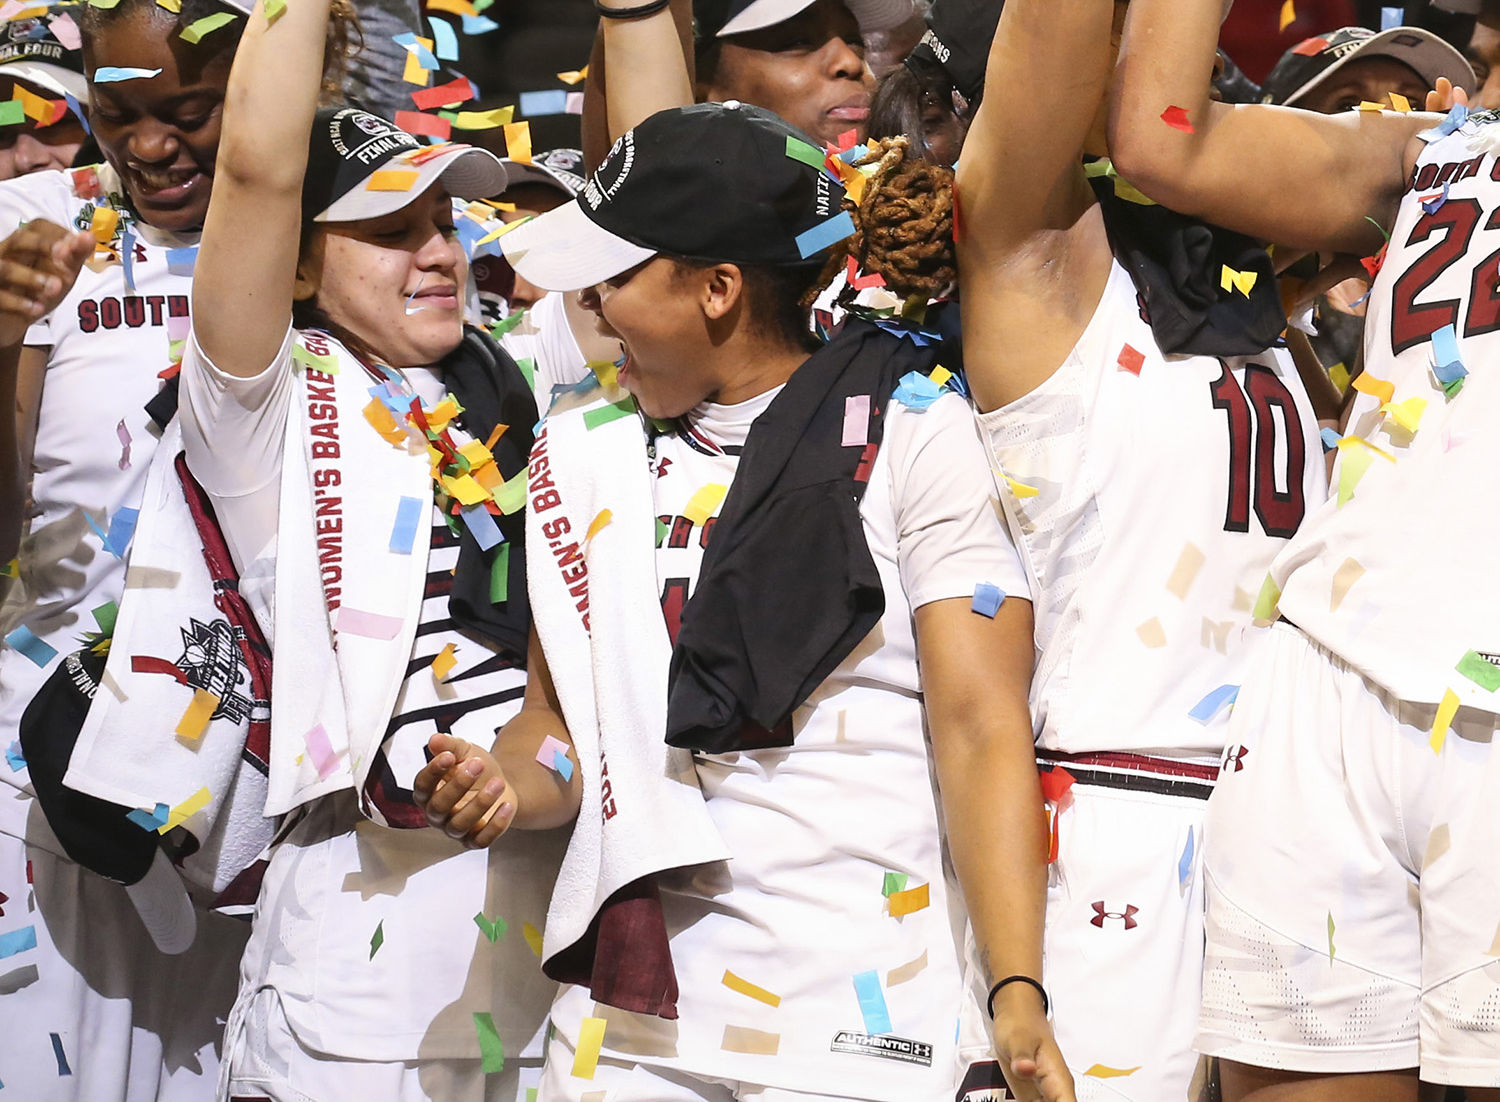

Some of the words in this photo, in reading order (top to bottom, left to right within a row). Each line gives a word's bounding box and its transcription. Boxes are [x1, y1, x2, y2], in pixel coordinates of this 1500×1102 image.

[24, 43, 63, 58] FOUR
[356, 136, 400, 165] FINAL
[77, 295, 190, 334] SOUTH
[1209, 356, 1306, 540] 10
[215, 625, 233, 668] FINAL
[207, 666, 230, 704] FOU
[837, 1033, 911, 1052] AUTHENTIC
